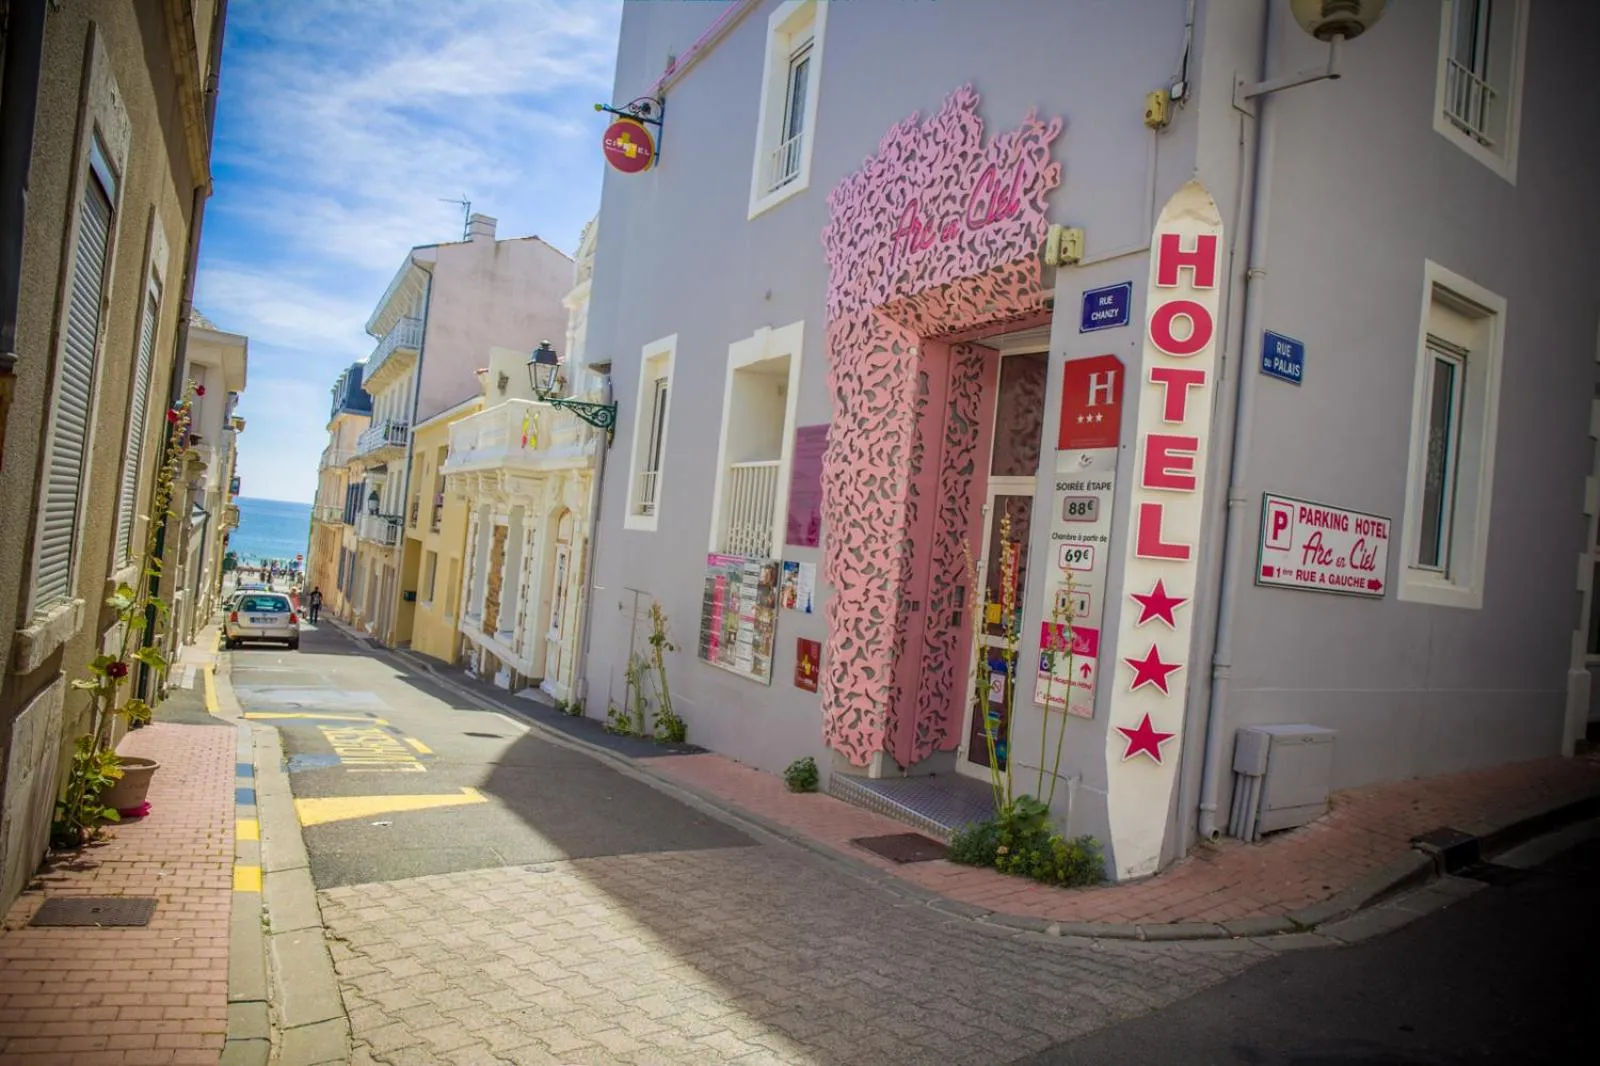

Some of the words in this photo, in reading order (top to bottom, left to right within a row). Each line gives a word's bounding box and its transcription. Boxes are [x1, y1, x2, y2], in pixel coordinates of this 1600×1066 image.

[889, 198, 937, 267] Arc
[966, 158, 1025, 231] Ciel
[1099, 295, 1114, 306] RUE
[1091, 308, 1119, 321] CHANZY
[1276, 341, 1292, 358] RUE
[1273, 356, 1301, 377] PALAIS
[1086, 370, 1117, 407] H
[1135, 233, 1218, 561] HOTEL
[1056, 480, 1084, 491] SOIRÉE
[1086, 480, 1112, 491] ÉTAPE
[1069, 499, 1094, 515] 88€
[1272, 510, 1289, 541] P
[1299, 506, 1349, 532] PARKING
[1354, 518, 1387, 540] HOTEL
[1051, 532, 1077, 541] Chambre
[1082, 534, 1099, 543] partir
[1099, 535, 1108, 543] de
[1065, 548, 1090, 563] 69€
[1302, 531, 1334, 566] Arc
[1349, 538, 1378, 572] Ciel
[1295, 569, 1317, 583] RUE
[1328, 573, 1366, 589] GAUCHE
